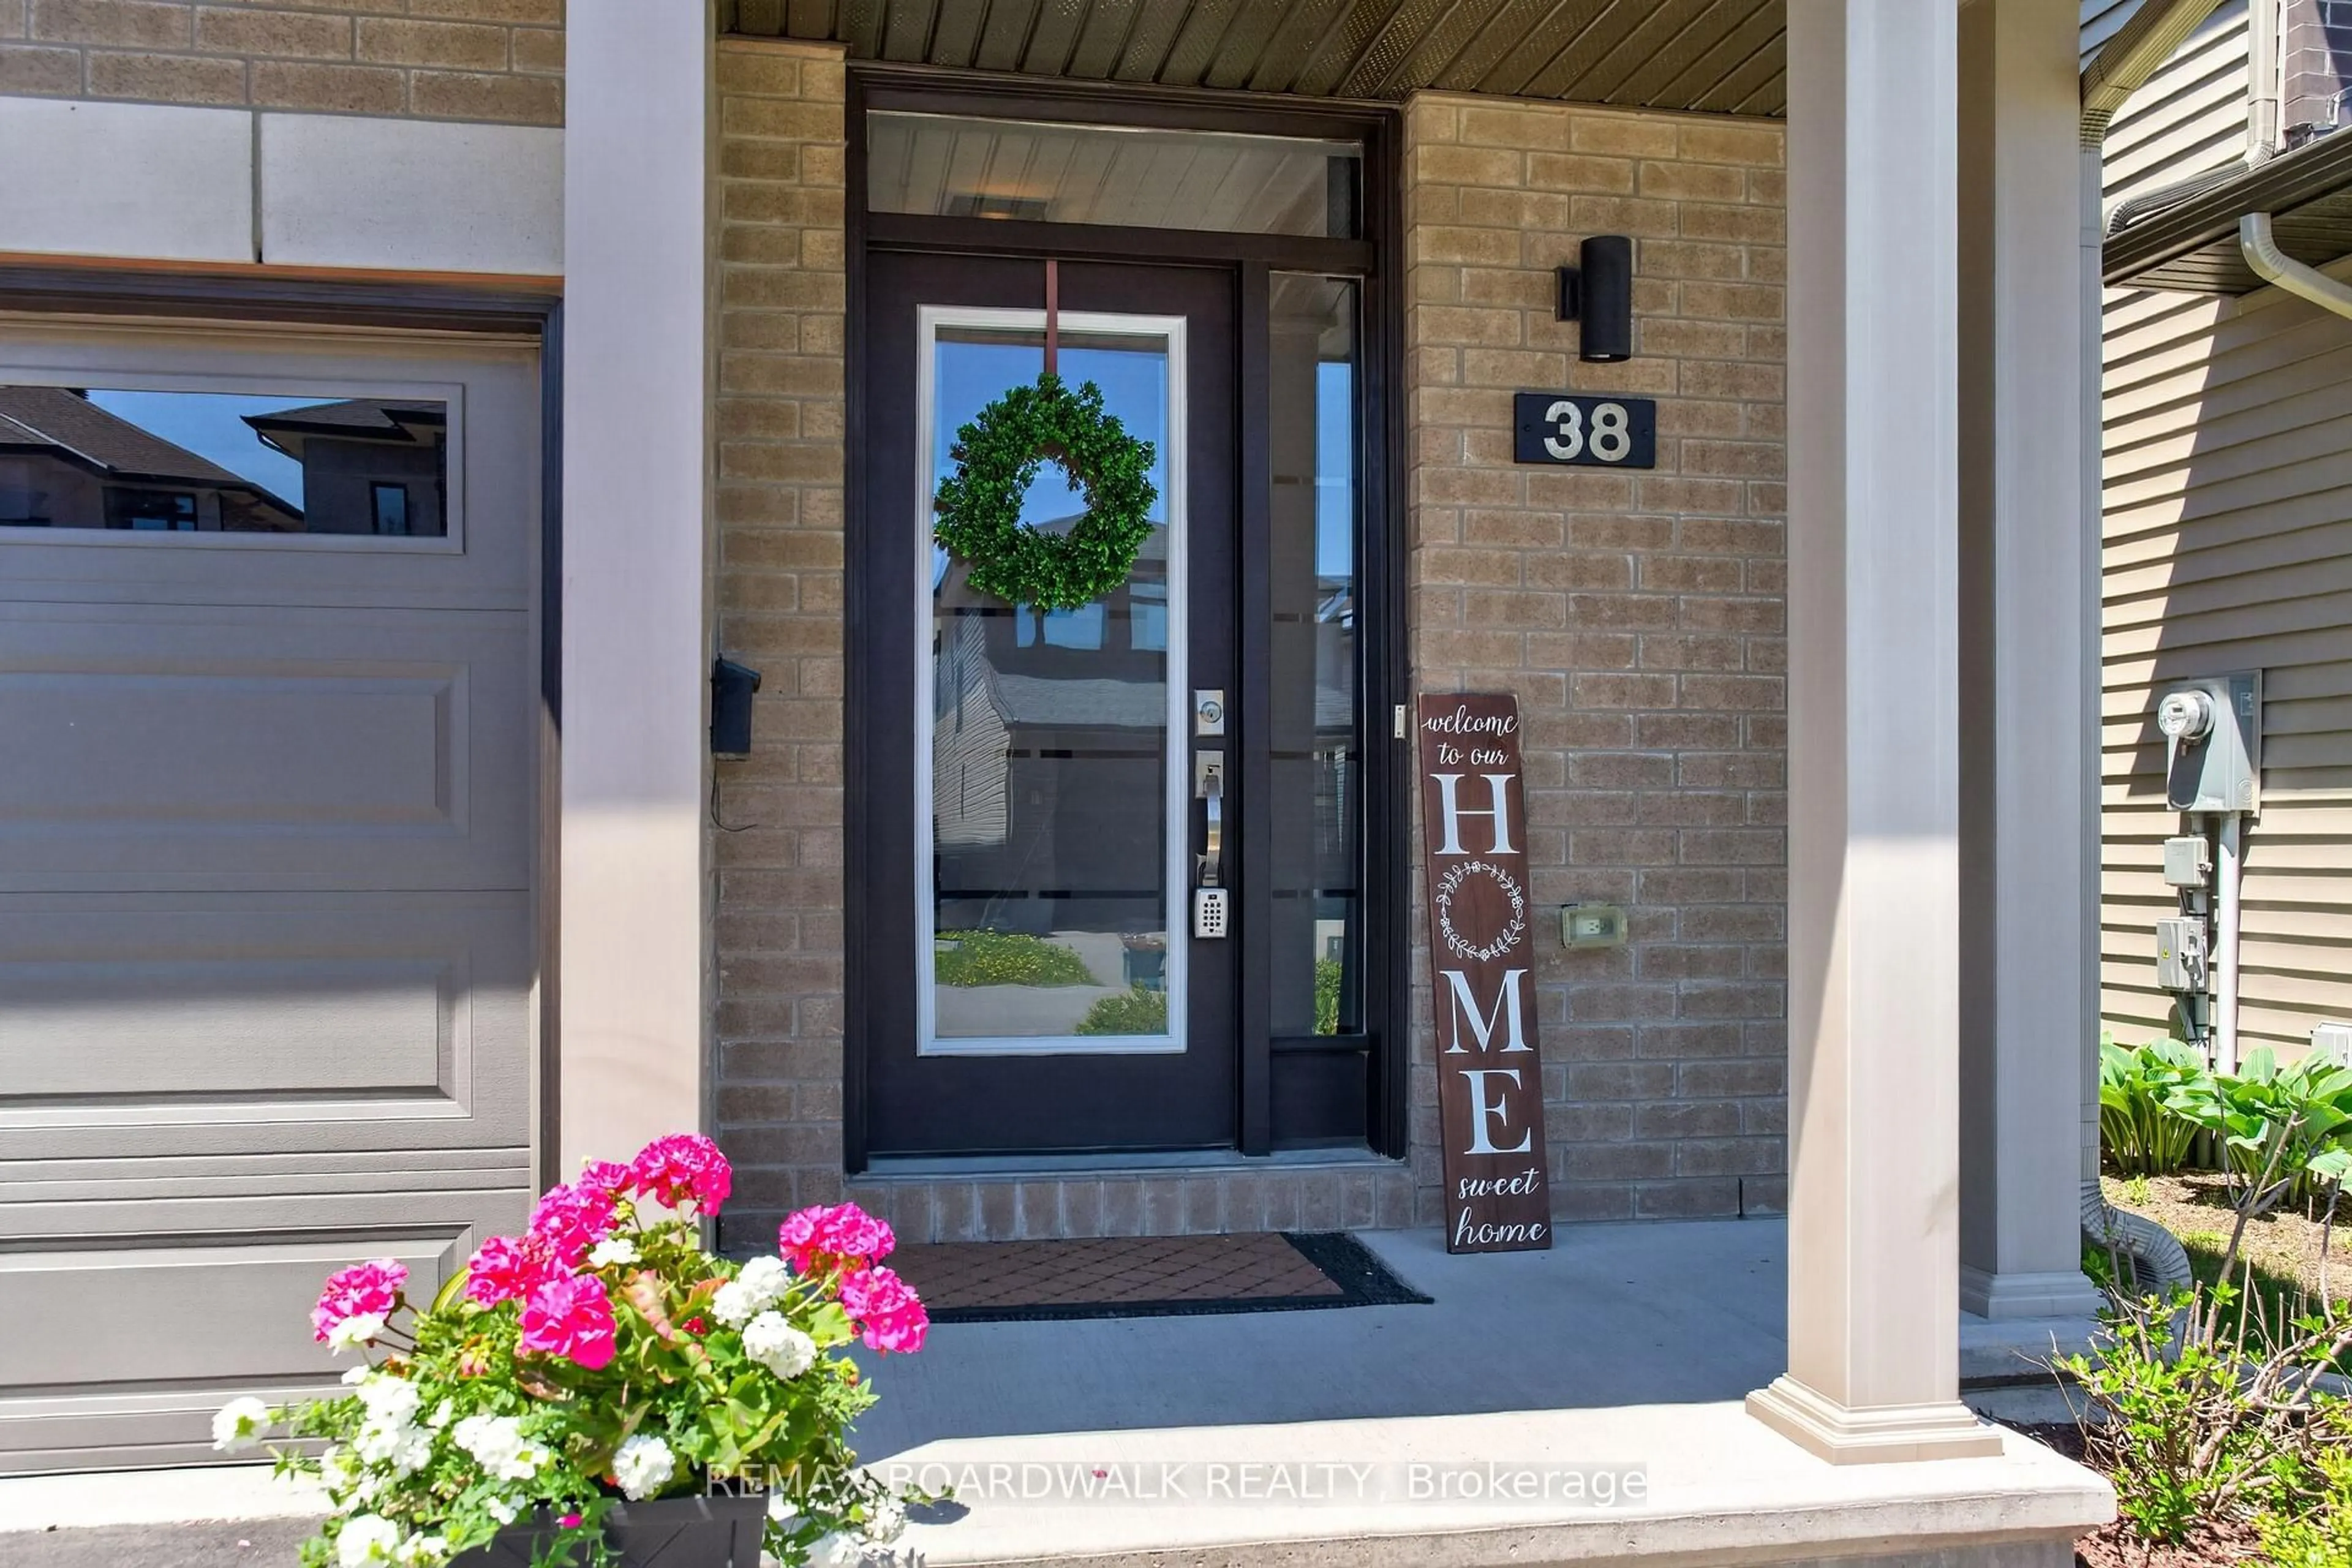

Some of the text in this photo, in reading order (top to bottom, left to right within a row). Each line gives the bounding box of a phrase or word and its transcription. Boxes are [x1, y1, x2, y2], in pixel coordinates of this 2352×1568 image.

[1544, 401, 1631, 461] 38
[1421, 704, 1520, 736] welcome
[1437, 742, 1509, 766] to our
[1458, 1167, 1540, 1199] sweet
[1454, 1206, 1548, 1246] home
